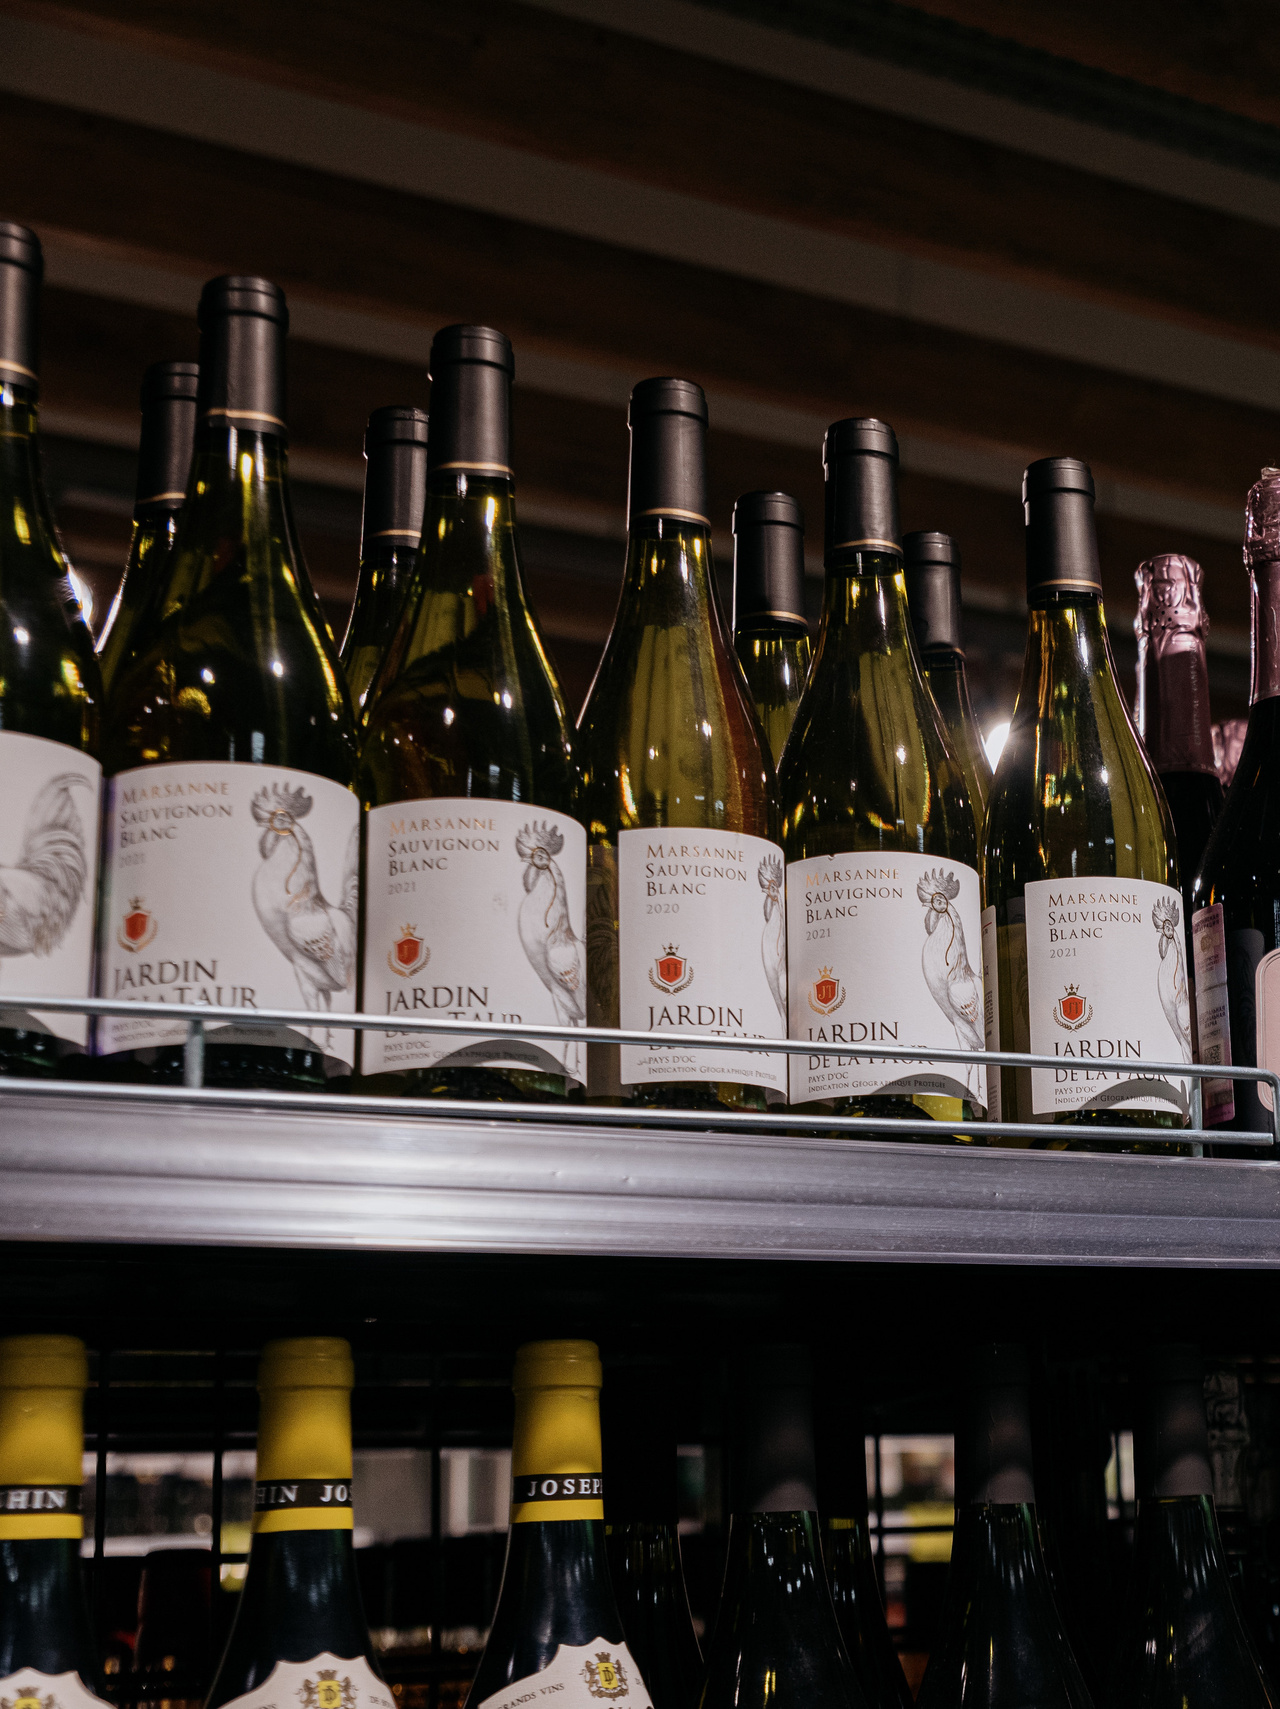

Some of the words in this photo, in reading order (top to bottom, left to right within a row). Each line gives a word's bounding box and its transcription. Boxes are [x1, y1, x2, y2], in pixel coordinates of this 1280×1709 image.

[122, 782, 230, 805] MARSANNE
[120, 804, 233, 829] SAUVIGNON
[389, 817, 497, 838] MARSANNE
[120, 826, 178, 849] BLANC
[388, 838, 500, 858] SAUVIGNON
[647, 844, 744, 862] MARSANNE
[389, 857, 448, 876] BLANC
[645, 862, 747, 882] SAUVIGNON
[806, 868, 900, 888] MARSANNE
[647, 881, 706, 897] BLANC
[805, 887, 903, 907] SAUVIGNON
[647, 903, 680, 914] 2020
[1048, 892, 1138, 908] MARSANNE
[806, 905, 858, 924] BLANC
[1048, 910, 1142, 926] SAUVIGNON
[806, 928, 831, 941] 2021
[1049, 927, 1103, 943] BLANC
[1050, 947, 1077, 959] 2021
[113, 959, 217, 994] JARDIN
[386, 986, 489, 1015] JARDIN
[648, 1004, 743, 1031] JARDIN
[808, 1021, 899, 1043] JARDIN
[1054, 1040, 1141, 1058] JARDIN
[648, 1056, 670, 1065] PAYS
[672, 1055, 697, 1064] D'OC
[648, 1065, 697, 1075] INDICATION
[808, 1073, 825, 1084] PAYS
[827, 1071, 849, 1081] D'OC
[808, 1082, 849, 1093] INDICATION
[1054, 1087, 1074, 1096] PAYS
[1075, 1086, 1097, 1094] D'OC
[1054, 1096, 1098, 1105] INDICATION
[320, 1484, 352, 1502] JO
[527, 1478, 603, 1497] JOSEP
[0, 1488, 67, 1509] HIN
[539, 1683, 565, 1695] VINS
